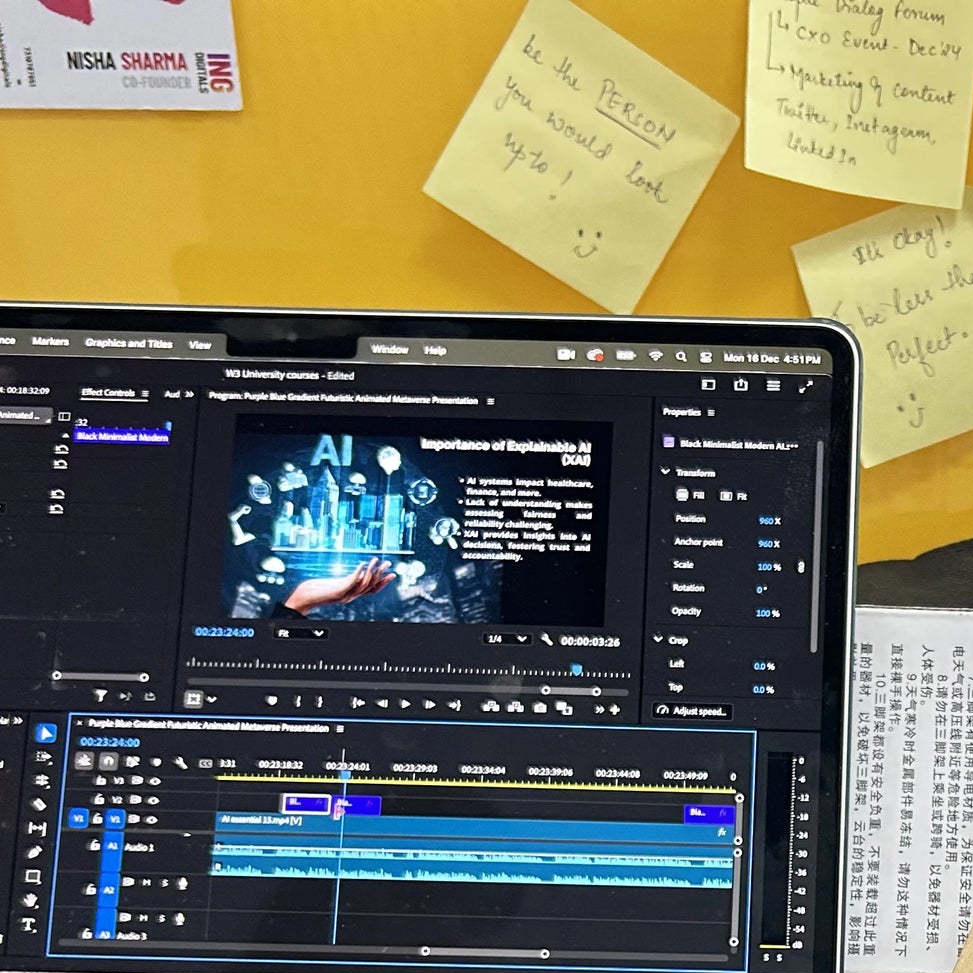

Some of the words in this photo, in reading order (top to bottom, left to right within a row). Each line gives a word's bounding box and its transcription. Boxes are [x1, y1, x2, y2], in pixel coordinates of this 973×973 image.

[842, 31, 889, 51] Event
[67, 51, 117, 70] NISHA
[120, 52, 188, 71] SHARMA
[195, 52, 210, 94] DIGITALS
[207, 54, 235, 93] ING
[122, 76, 192, 89] CO-FOUNDER
[522, 33, 543, 65] be
[553, 56, 581, 91] the
[599, 78, 677, 143] PERSON
[495, 75, 532, 111] you
[545, 112, 613, 160] would
[32, 336, 70, 346] Markers
[85, 338, 126, 350] Graphics
[128, 340, 146, 348] and
[147, 339, 174, 350] Titles
[188, 340, 212, 350] View
[371, 344, 409, 355] Window
[424, 345, 447, 357] Help
[723, 353, 746, 363] Mon
[747, 354, 758, 363] 16
[760, 354, 780, 364] Dec
[224, 368, 241, 378] W3
[242, 369, 286, 381] University
[286, 371, 320, 380] courses
[327, 371, 356, 381] Edited
[81, 388, 104, 398] Effect
[104, 388, 136, 398] Controls
[208, 391, 244, 401] Program:
[287, 393, 320, 402] Gradient
[320, 394, 354, 402] Futuristic
[354, 395, 392, 404] Animated
[432, 396, 478, 406] Presentation
[662, 407, 702, 418] Properties
[310, 434, 353, 466] AI
[420, 438, 490, 452] Importance
[491, 440, 506, 451] of
[506, 440, 577, 454] Explainable
[680, 440, 702, 448] Black
[703, 441, 744, 450] Minimalist
[745, 442, 775, 450] Modern
[561, 454, 592, 467] (XAI)
[675, 468, 716, 478] Transform
[675, 514, 706, 524] Position
[674, 538, 702, 547] Anchor
[702, 538, 724, 548] point
[673, 560, 694, 569] Scale
[672, 584, 706, 593] Rotation
[671, 606, 702, 618] Opacity
[194, 626, 255, 638] 00:23:24:00
[560, 636, 621, 648] 00:00:03:26
[668, 636, 689, 647] Crop
[669, 659, 685, 668] Left
[668, 683, 684, 693] Top
[673, 707, 698, 717] Adjust
[258, 760, 304, 770] 00:23:18:32
[326, 762, 371, 772] 00:23:24:01
